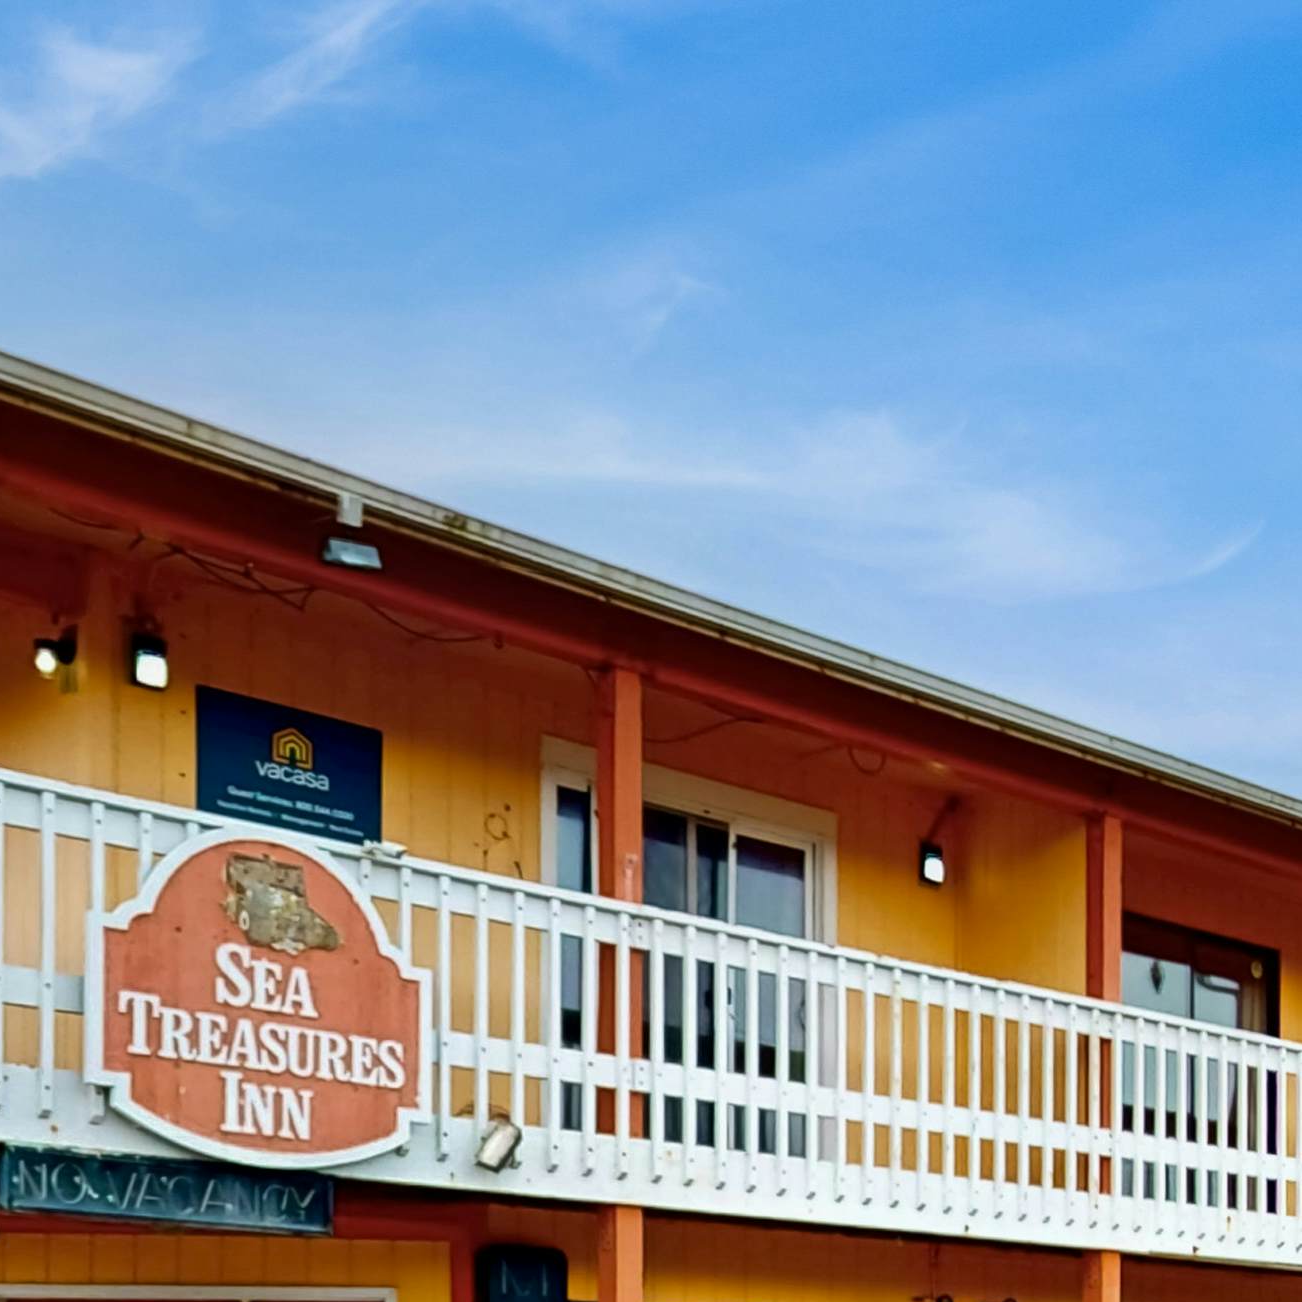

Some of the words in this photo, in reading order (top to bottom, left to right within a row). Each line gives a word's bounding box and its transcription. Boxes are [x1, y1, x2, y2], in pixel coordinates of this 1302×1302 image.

[254, 760, 330, 791] vacasa
[215, 942, 319, 1019] SEA
[117, 990, 407, 1089] TREASURES
[219, 1070, 314, 1141] INN
[17, 1160, 88, 1204] NO
[106, 1170, 315, 1221] VACANCY
